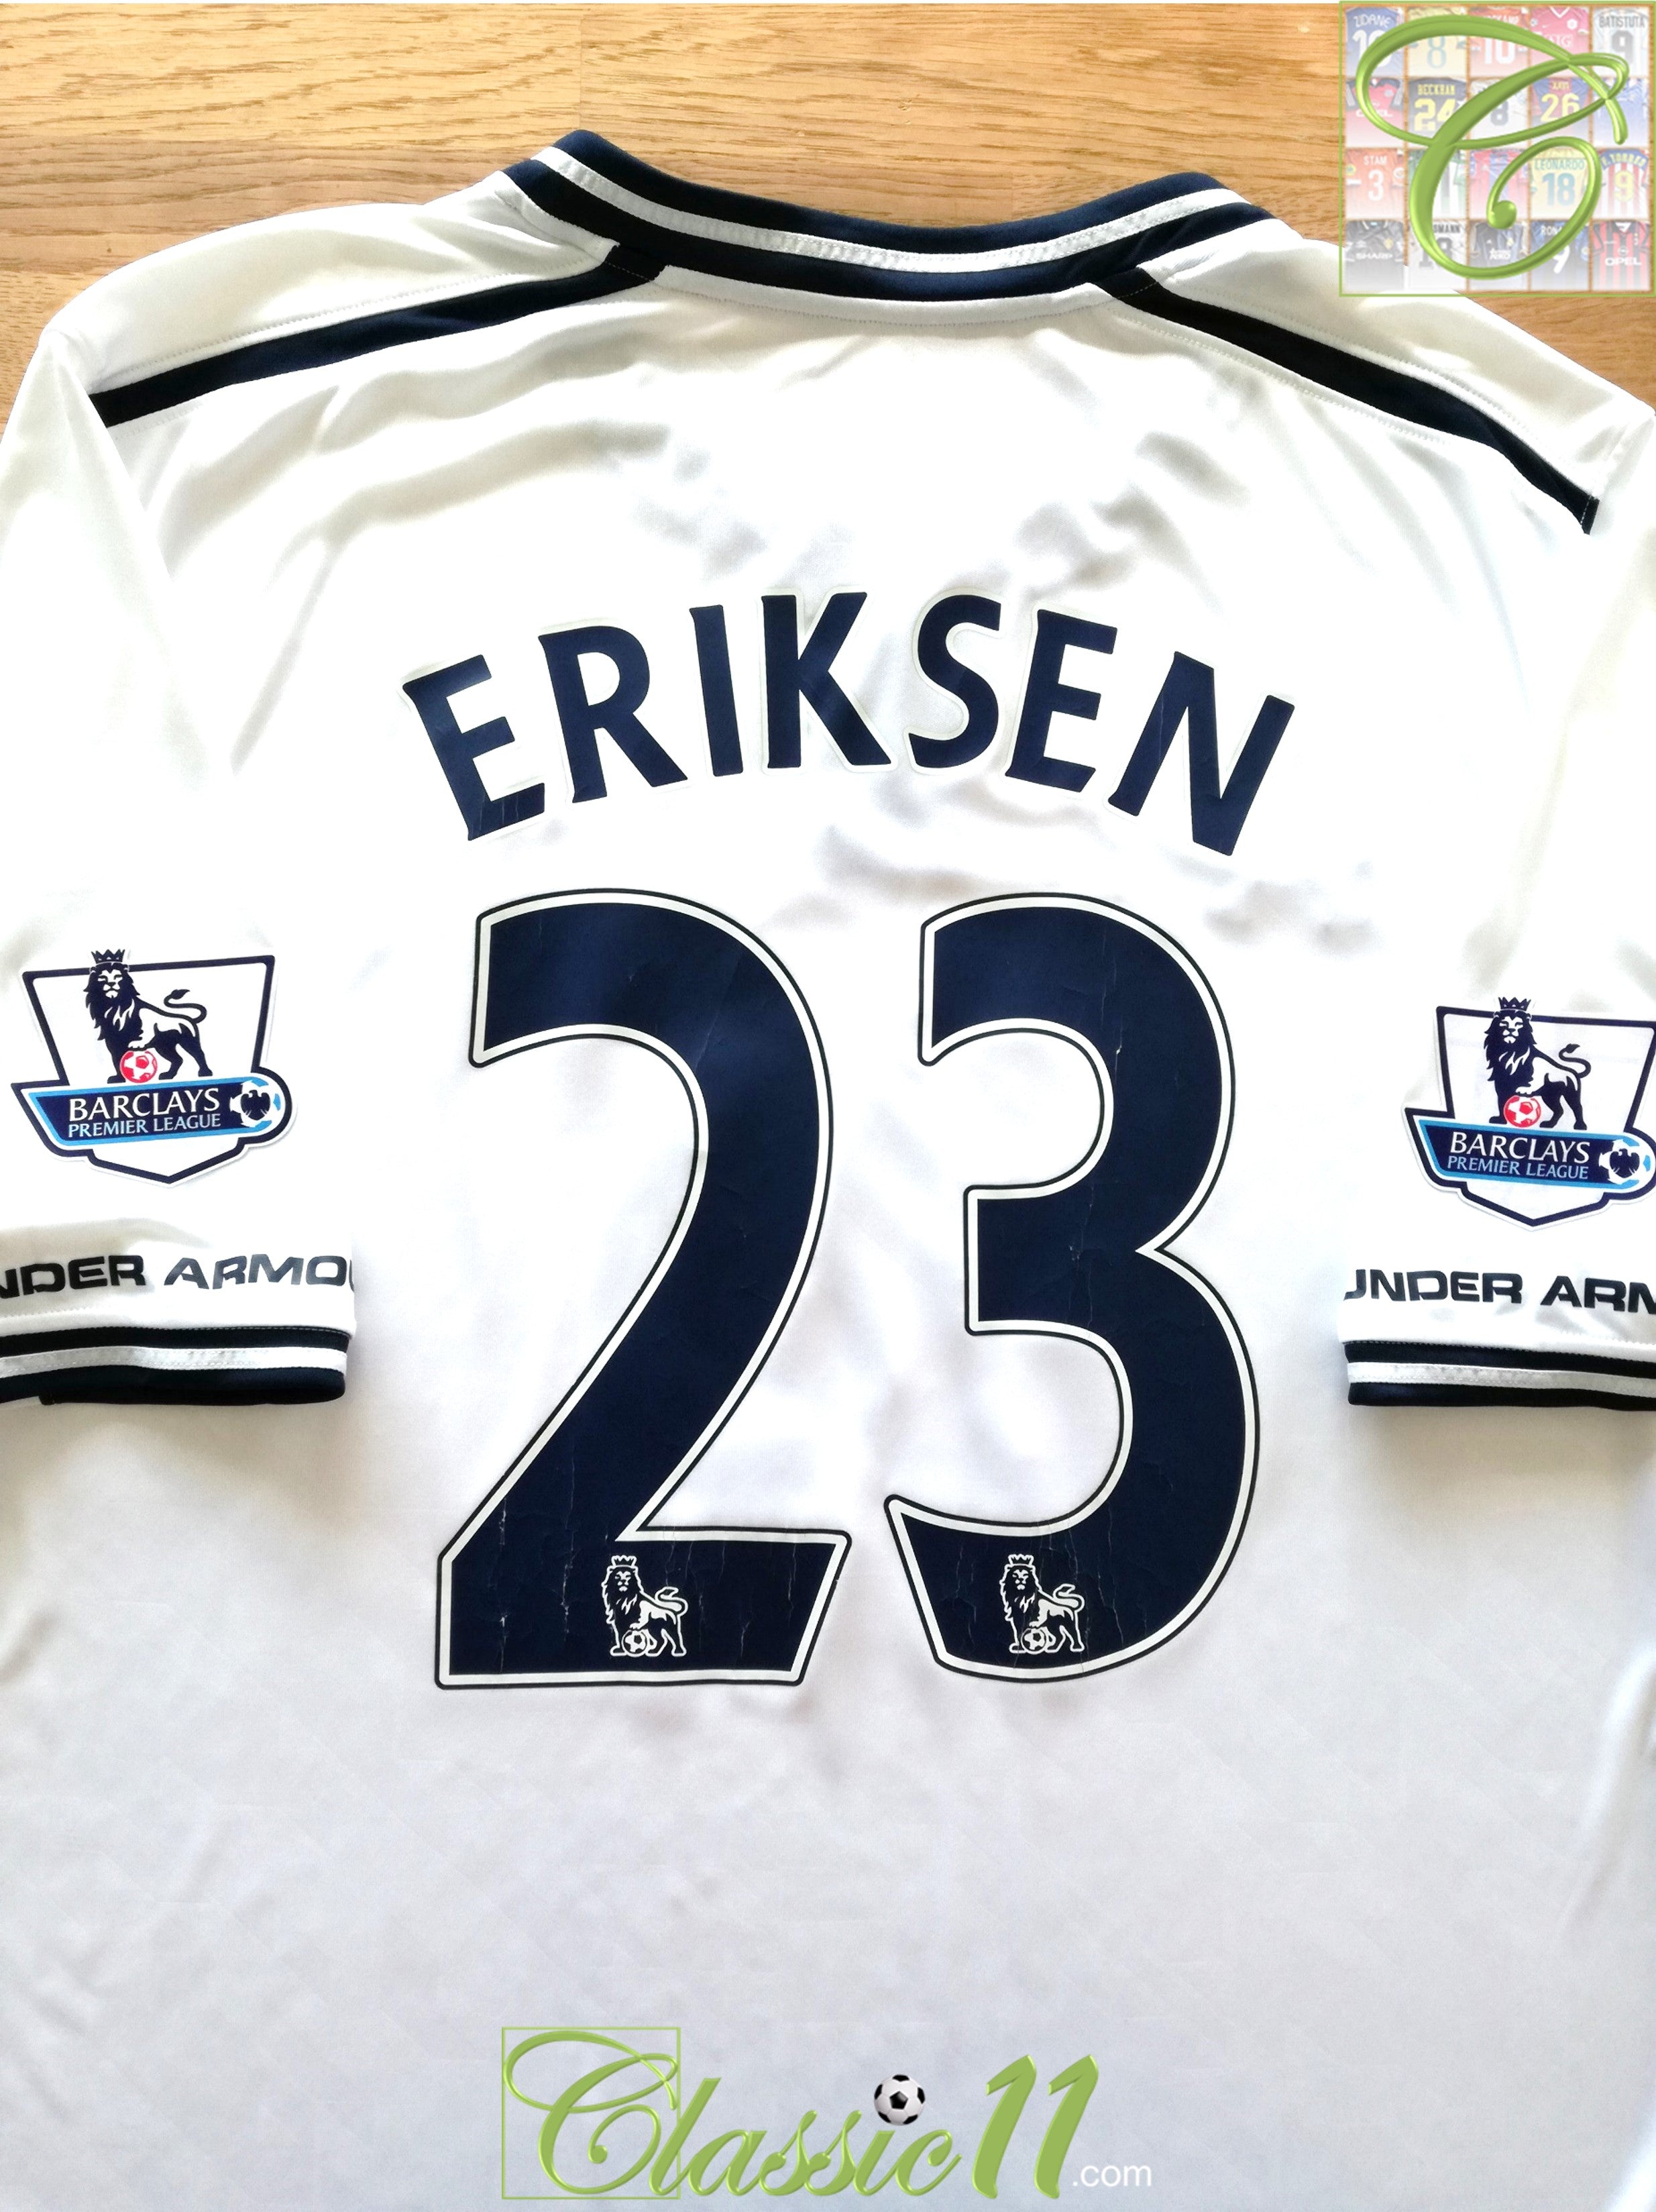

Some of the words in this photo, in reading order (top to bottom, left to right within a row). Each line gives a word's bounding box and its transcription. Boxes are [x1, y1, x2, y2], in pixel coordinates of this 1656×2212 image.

[402, 592, 1295, 856] ERIKSEN
[68, 1088, 220, 1122] BARCLAYS
[68, 1120, 148, 1138] PREMIER
[154, 1113, 221, 1132] LEAGUE
[1449, 1131, 1590, 1164] BARCLAYS
[1447, 1155, 1521, 1175] PREMIER
[1526, 1162, 1589, 1179] LEAGUE
[164, 1253, 355, 1293] ARMO
[437, 887, 1260, 1687] 23
